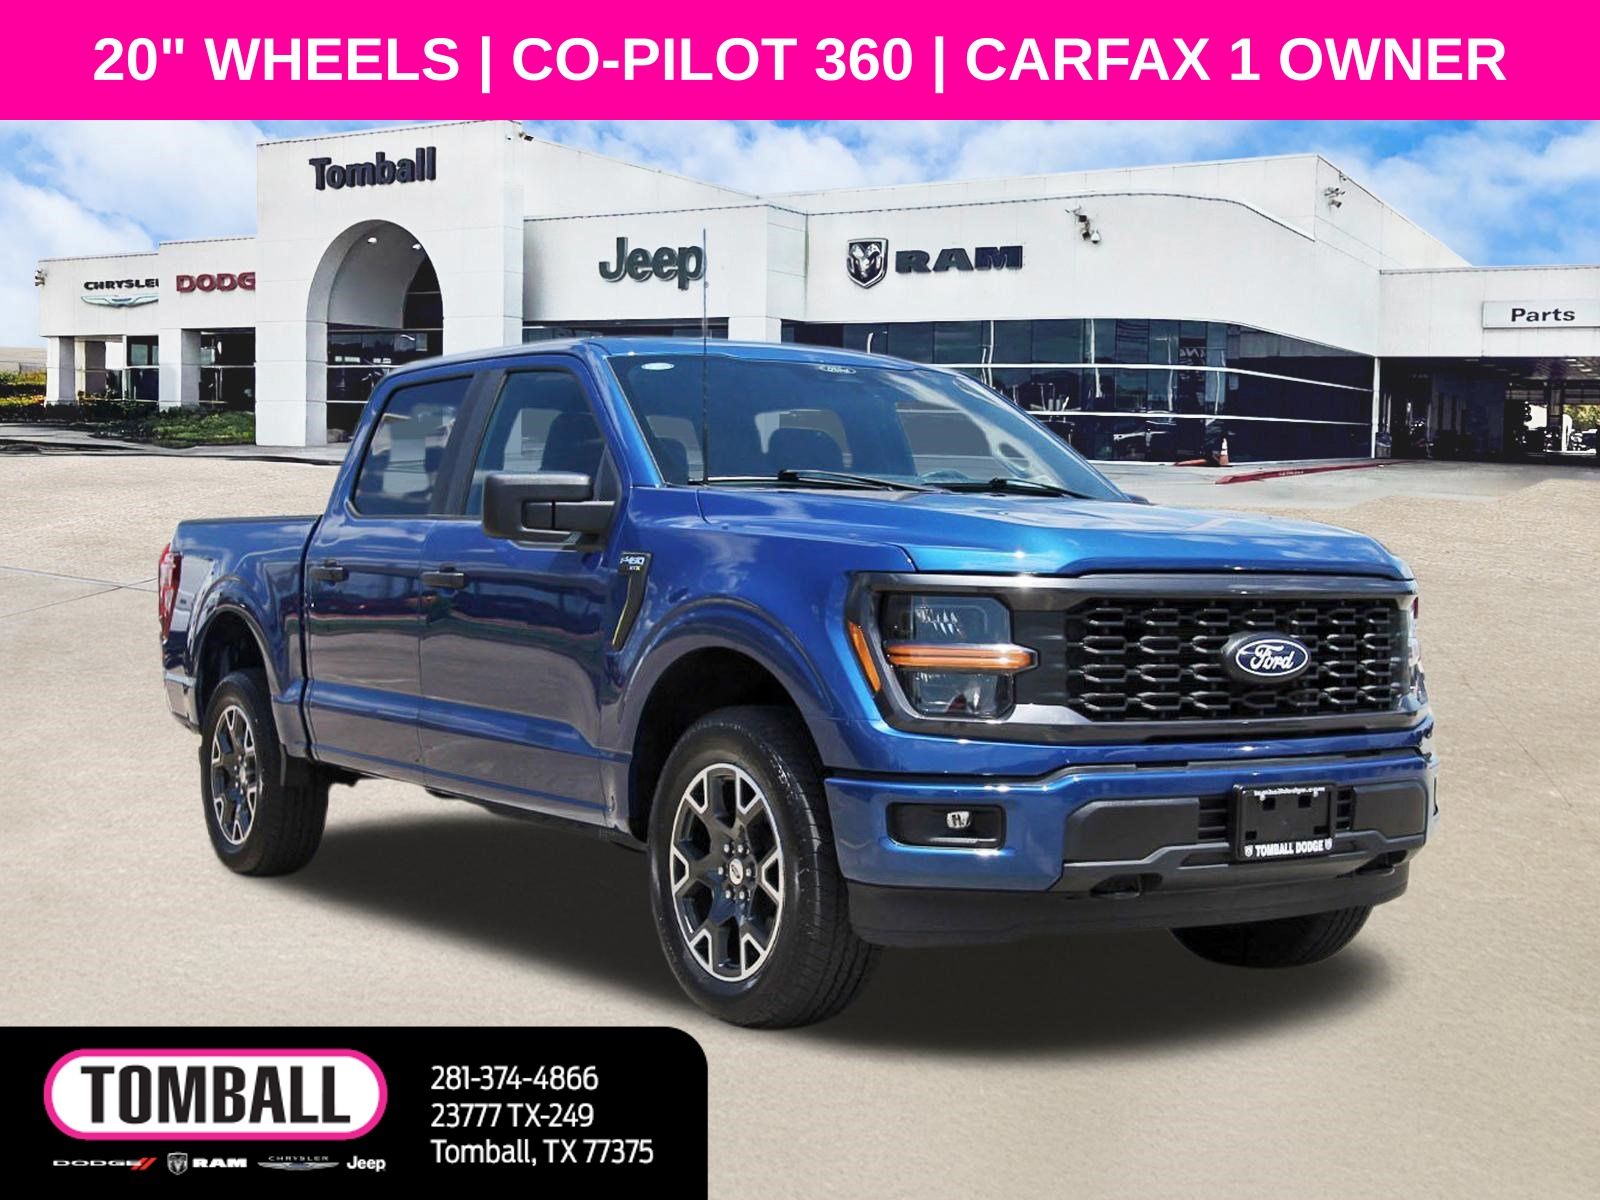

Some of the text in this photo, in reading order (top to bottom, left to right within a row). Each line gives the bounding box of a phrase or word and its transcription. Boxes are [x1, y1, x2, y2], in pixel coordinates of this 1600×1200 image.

[309, 146, 436, 190] Tomball
[599, 237, 705, 290] Jeep
[895, 246, 1023, 273] RAM
[1511, 308, 1576, 322] Parts
[1250, 644, 1296, 670] Ford
[1255, 838, 1324, 857] TOMBALL DODGE
